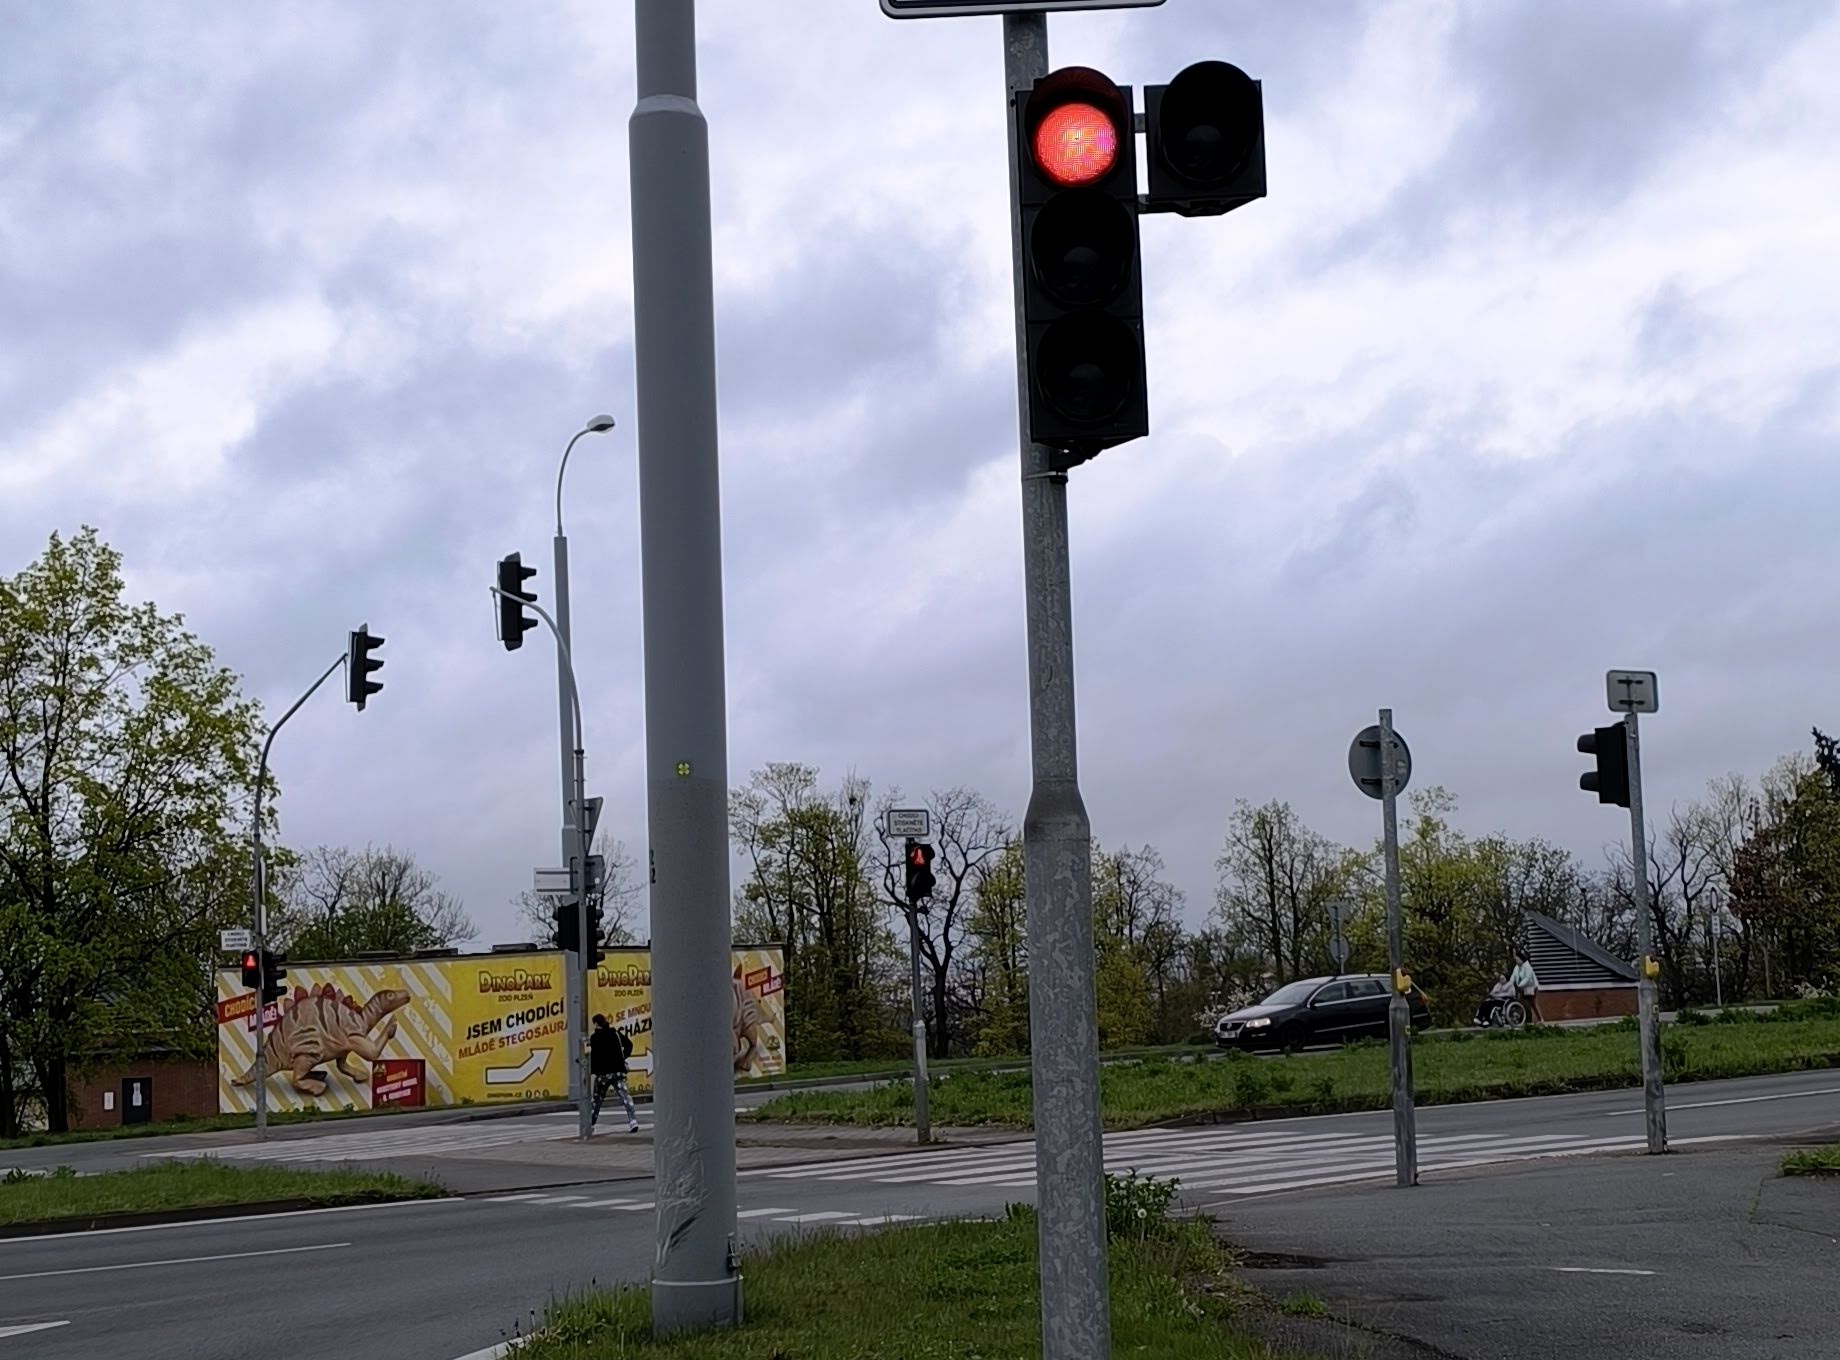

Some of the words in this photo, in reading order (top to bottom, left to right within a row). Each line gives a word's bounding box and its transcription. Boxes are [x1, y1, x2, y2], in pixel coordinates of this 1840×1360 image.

[225, 994, 256, 1018] CHODÍC
[498, 994, 512, 1002] ZOO
[466, 1018, 501, 1040] JSEM
[506, 997, 565, 1028] CHODÍCÍ
